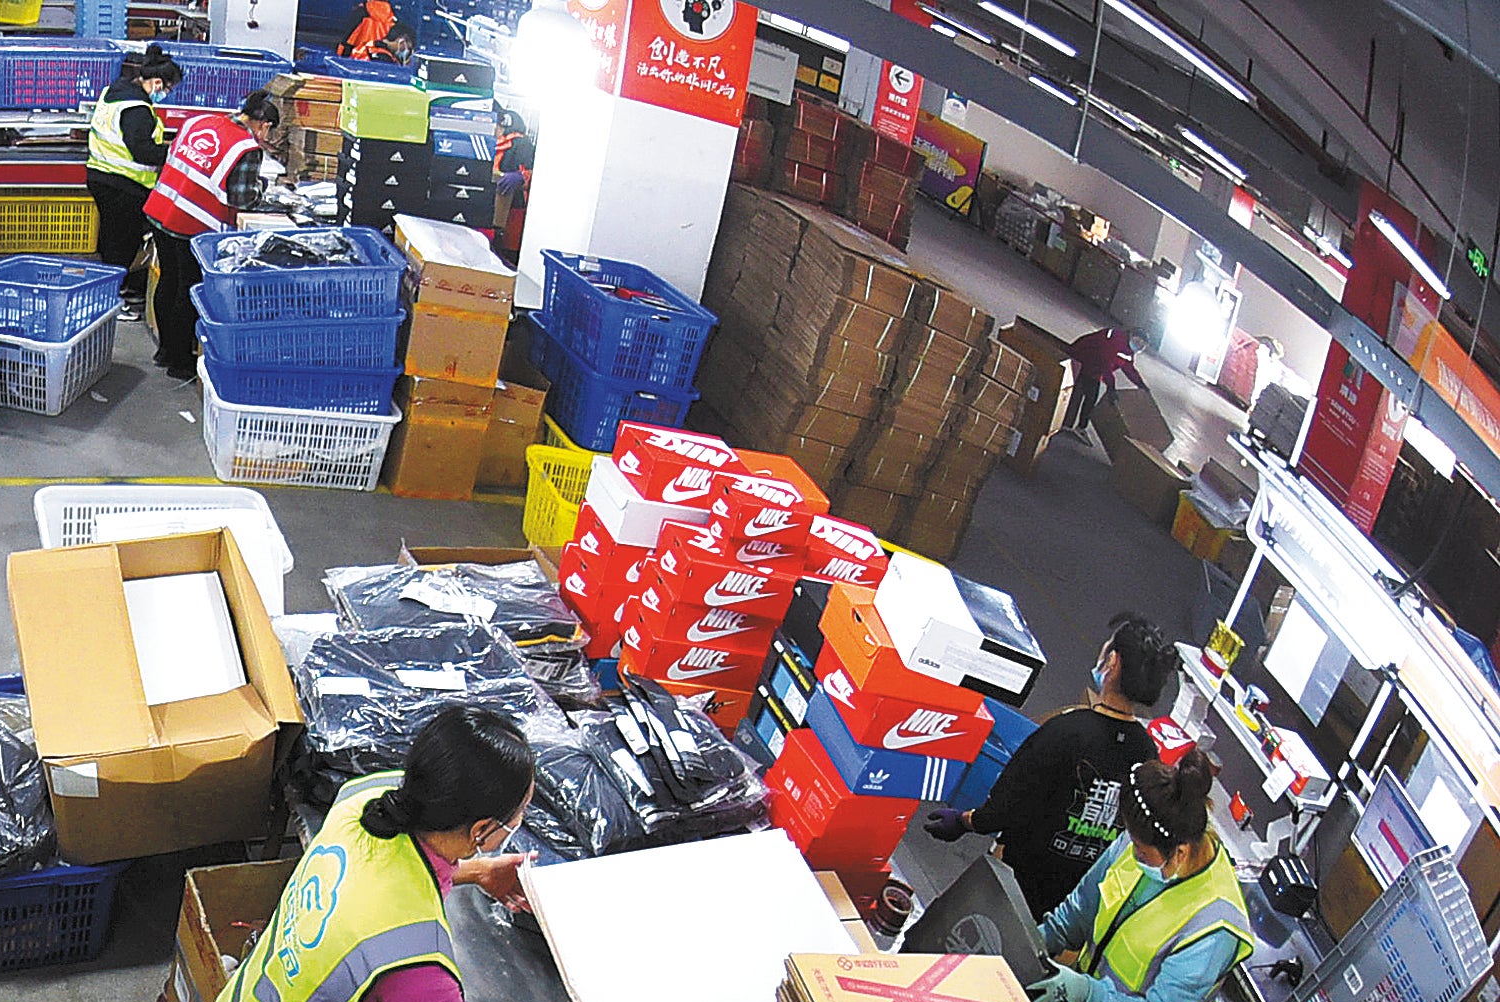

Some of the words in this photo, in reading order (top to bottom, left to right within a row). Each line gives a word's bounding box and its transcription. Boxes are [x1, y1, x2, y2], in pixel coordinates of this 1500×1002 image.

[647, 36, 727, 80] 创造不凡
[645, 433, 730, 467] NIKE
[675, 466, 712, 488] NIK
[732, 479, 795, 507] NIKE
[755, 507, 792, 526] NIKE
[746, 540, 782, 555] NIKE
[823, 557, 867, 581] NIKE
[718, 571, 768, 595] NIKE
[701, 608, 747, 630] NIKE
[681, 647, 730, 668] NIKE
[899, 708, 958, 736] NIKE
